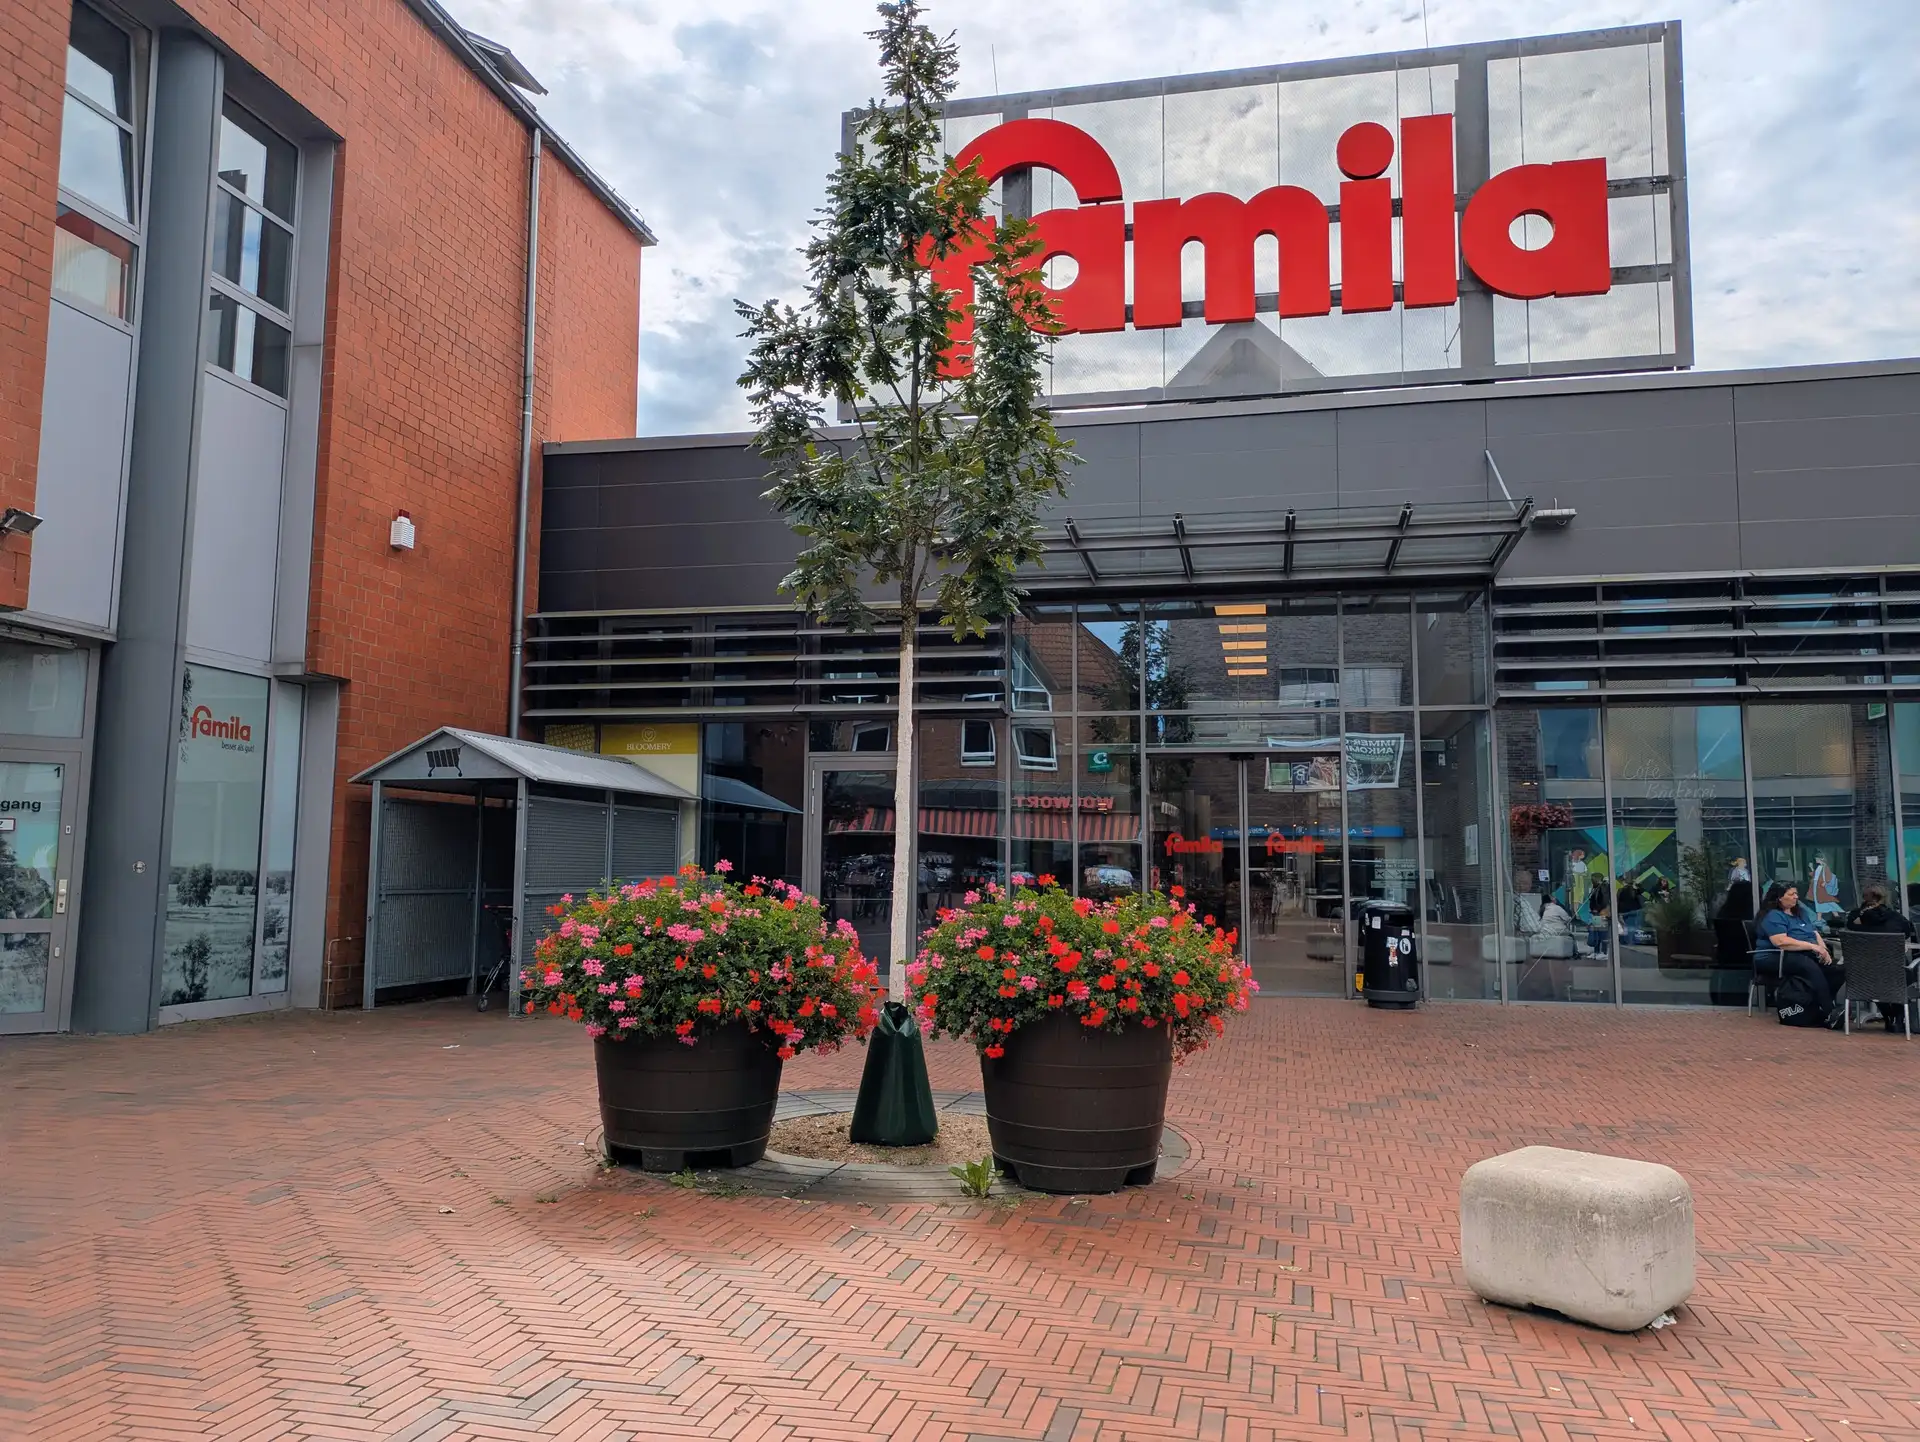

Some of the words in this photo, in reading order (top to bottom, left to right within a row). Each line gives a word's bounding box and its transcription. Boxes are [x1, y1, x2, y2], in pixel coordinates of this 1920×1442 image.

[915, 114, 1611, 380] famila
[189, 705, 252, 742] famila
[626, 742, 672, 751] BLOOMERY
[54, 766, 61, 778] 1
[1164, 832, 1224, 857] famila
[1265, 832, 1325, 857] famila
[1778, 1003, 1804, 1019] FILA
